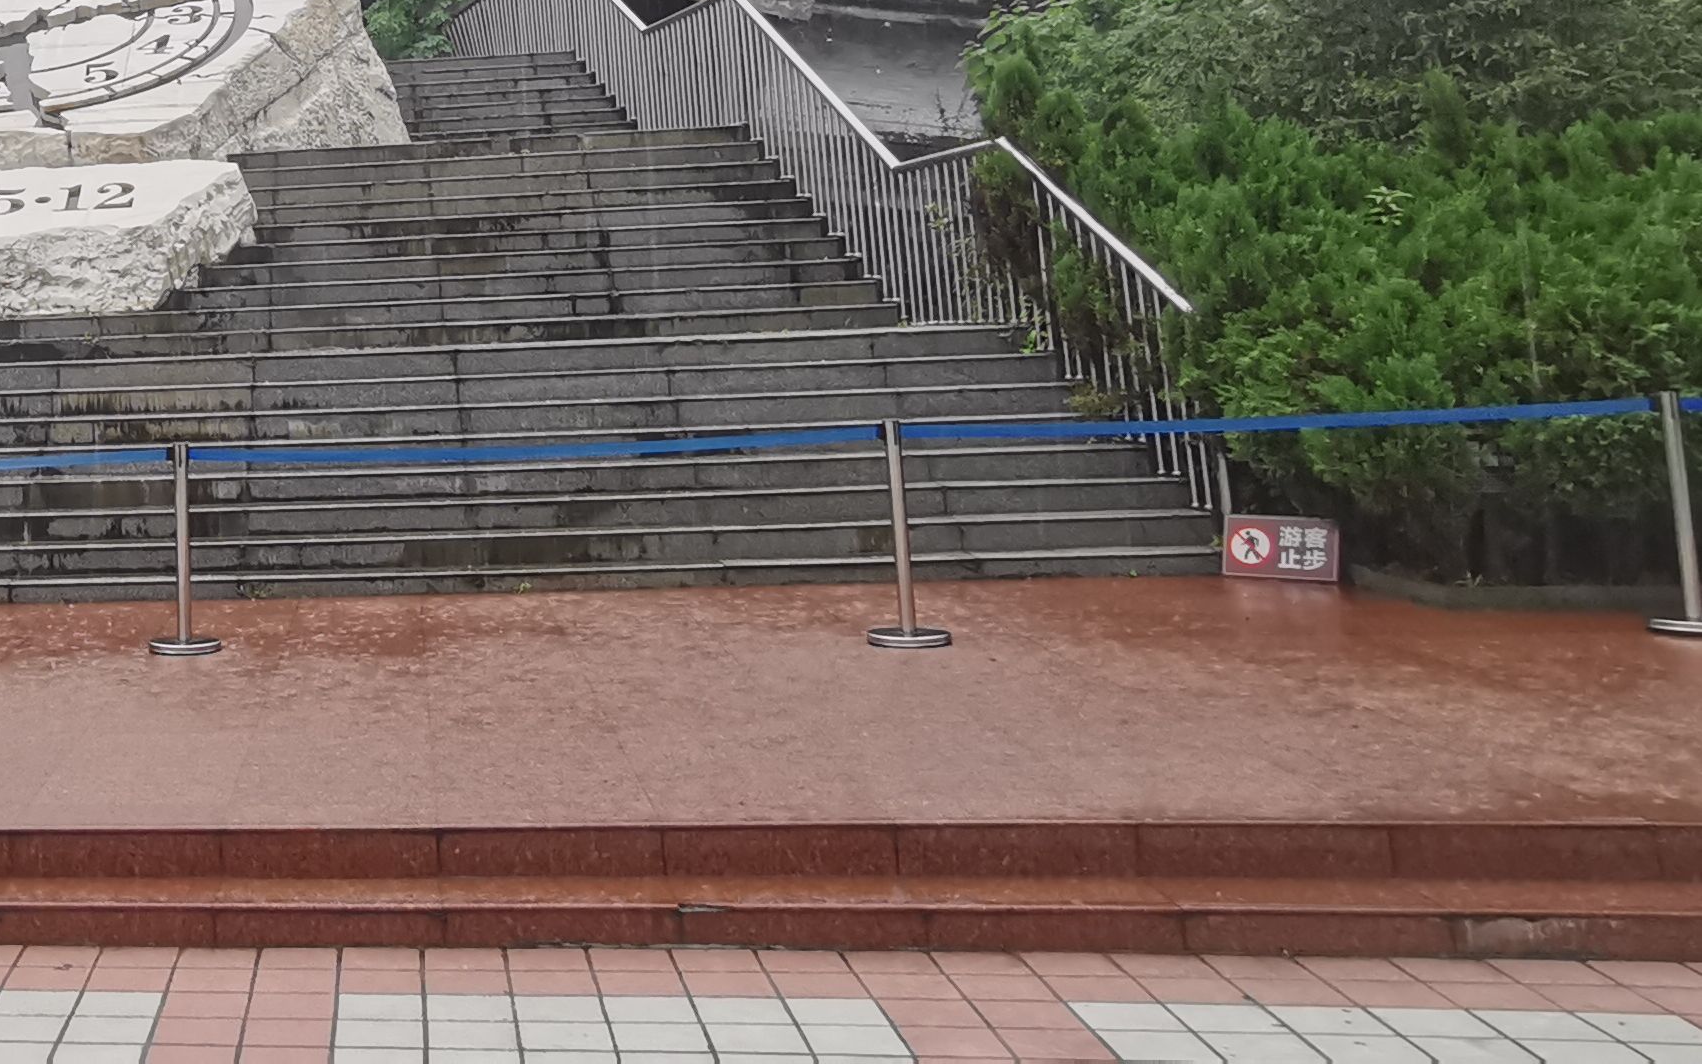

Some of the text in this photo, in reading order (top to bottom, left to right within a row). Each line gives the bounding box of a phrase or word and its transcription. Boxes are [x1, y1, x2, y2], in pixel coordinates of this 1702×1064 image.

[166, 5, 204, 26] 3
[135, 34, 174, 55] 4
[83, 61, 119, 84] 5
[1278, 526, 1329, 549] 游客
[1277, 549, 1328, 571] 止步
